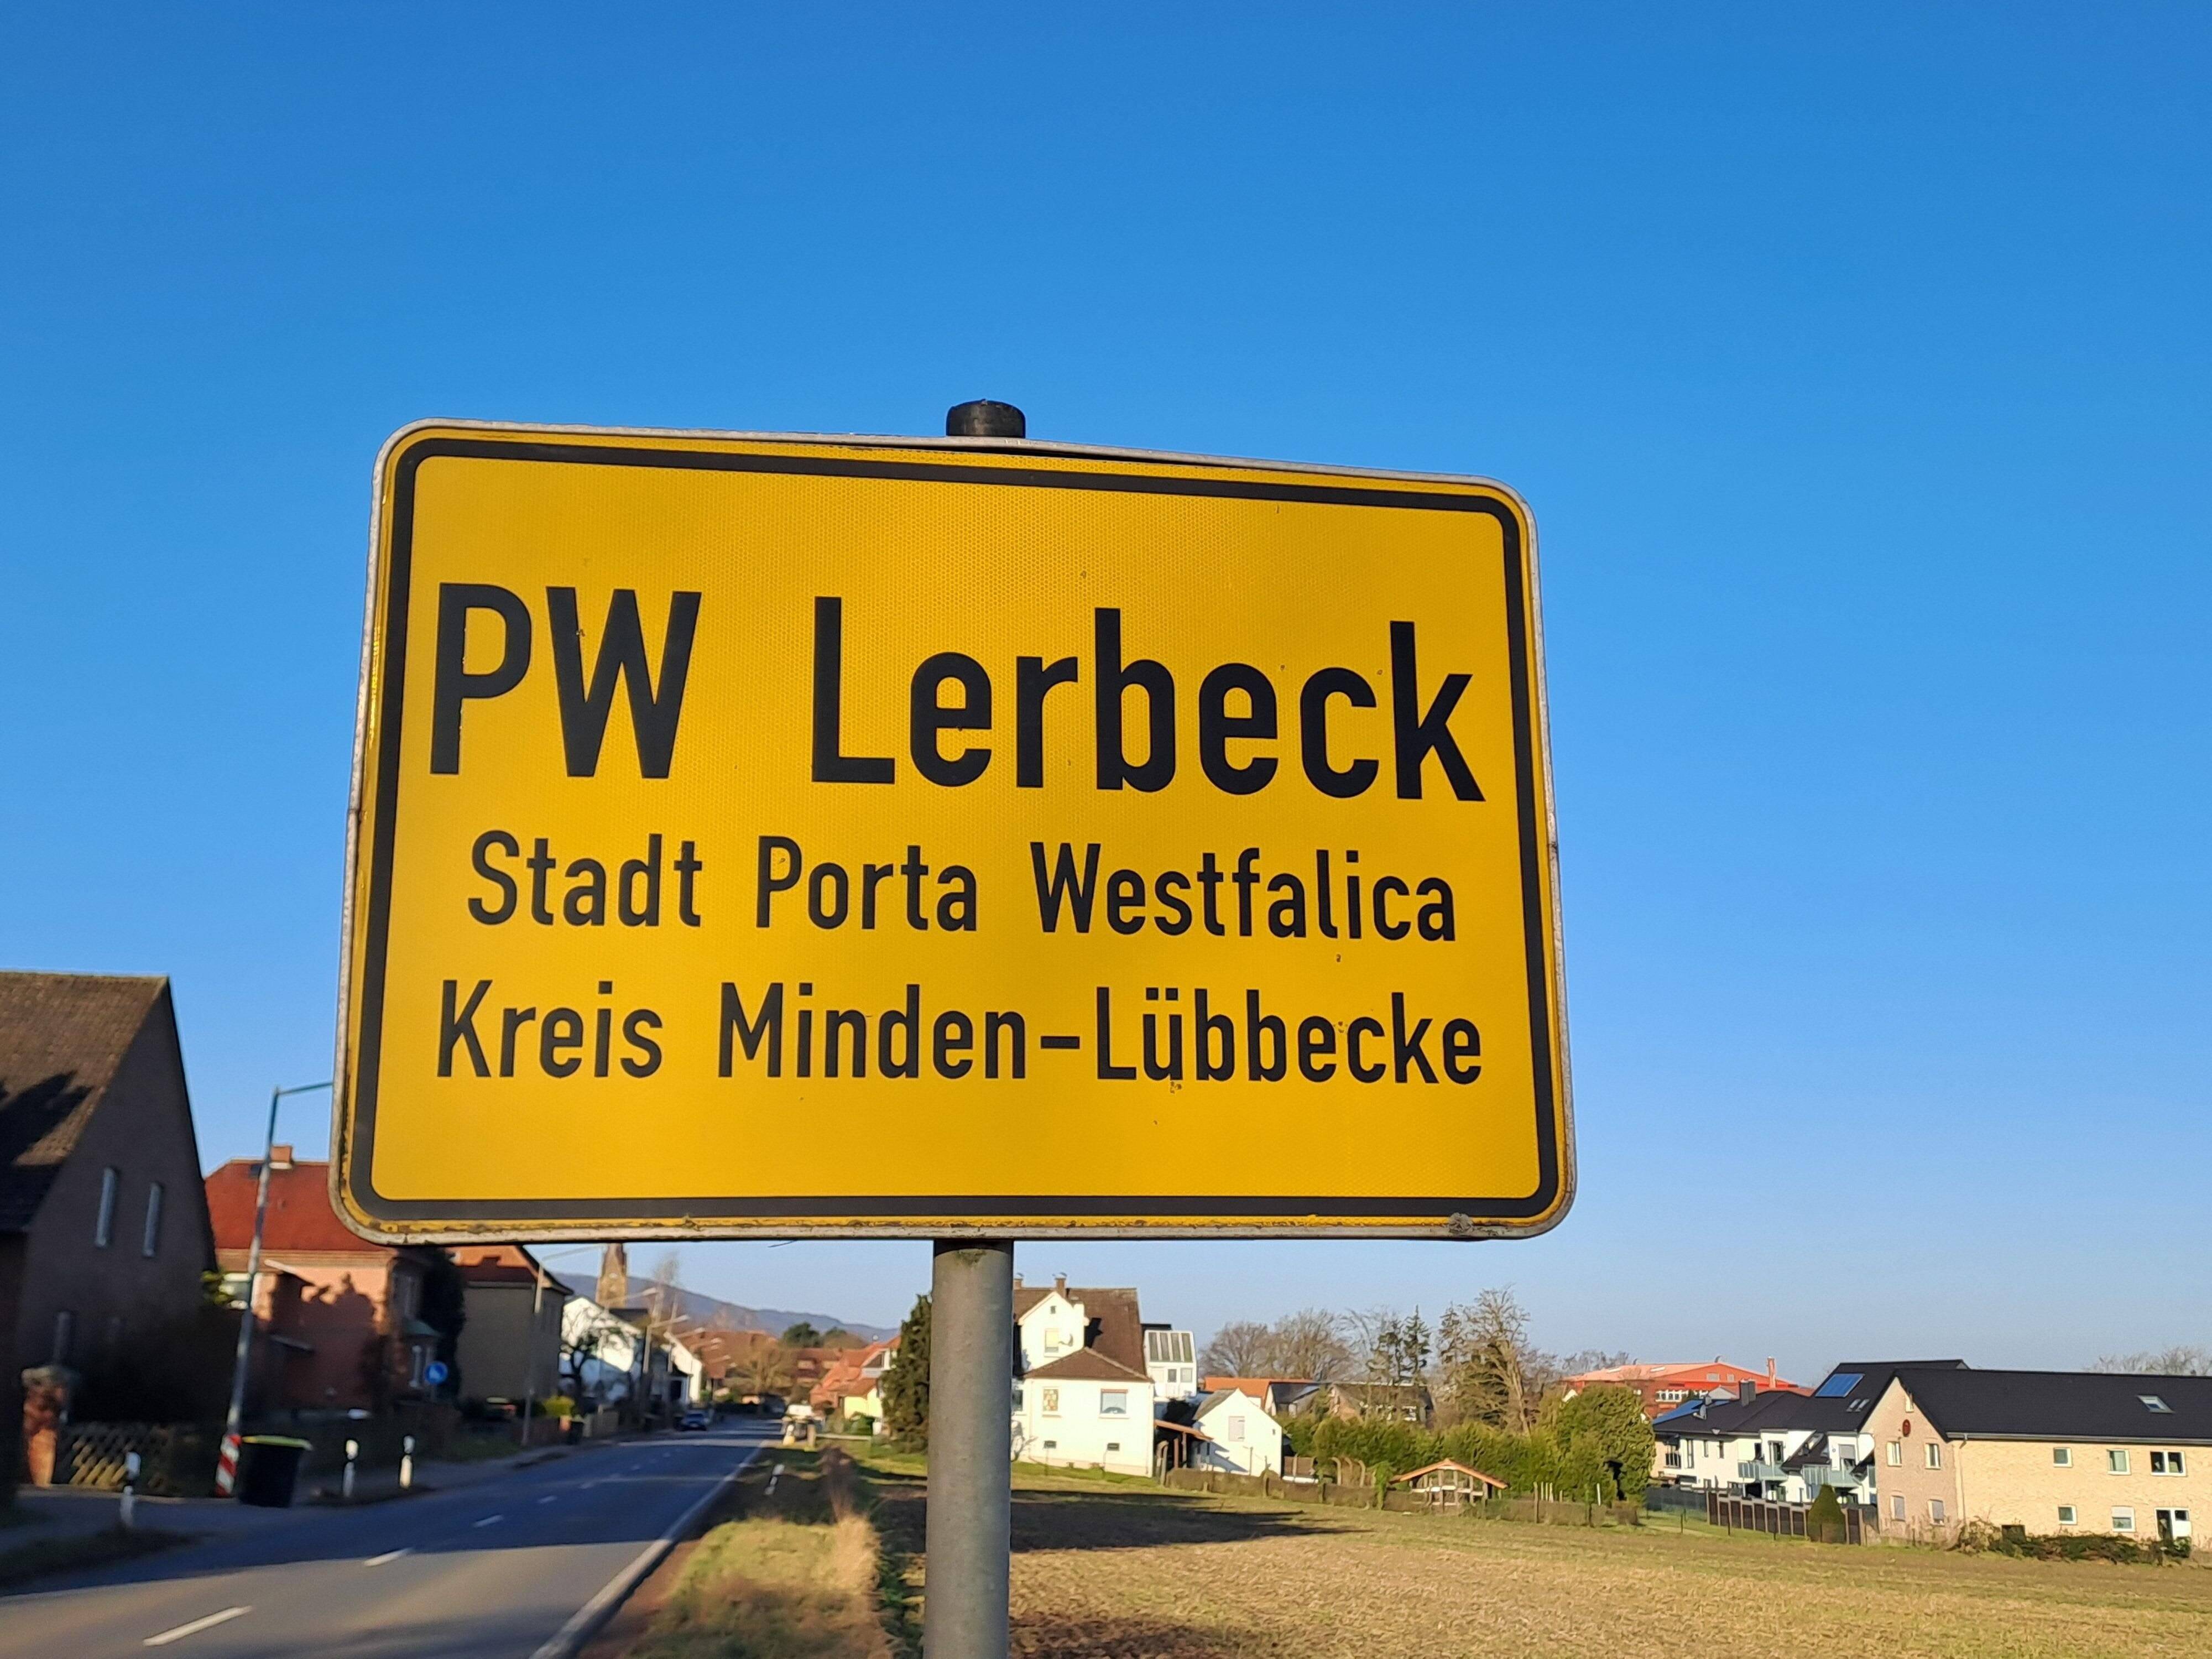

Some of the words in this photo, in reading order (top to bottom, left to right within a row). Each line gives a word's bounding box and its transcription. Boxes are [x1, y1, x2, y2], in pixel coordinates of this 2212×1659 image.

[430, 582, 702, 780] PW
[811, 596, 1486, 802] Lerbeck
[468, 830, 703, 927] Stadt
[756, 835, 977, 932] Porta
[1029, 841, 1456, 942] Westfalica
[437, 979, 663, 1079] Kreis
[718, 982, 1482, 1086] Minden-Lübbecke
